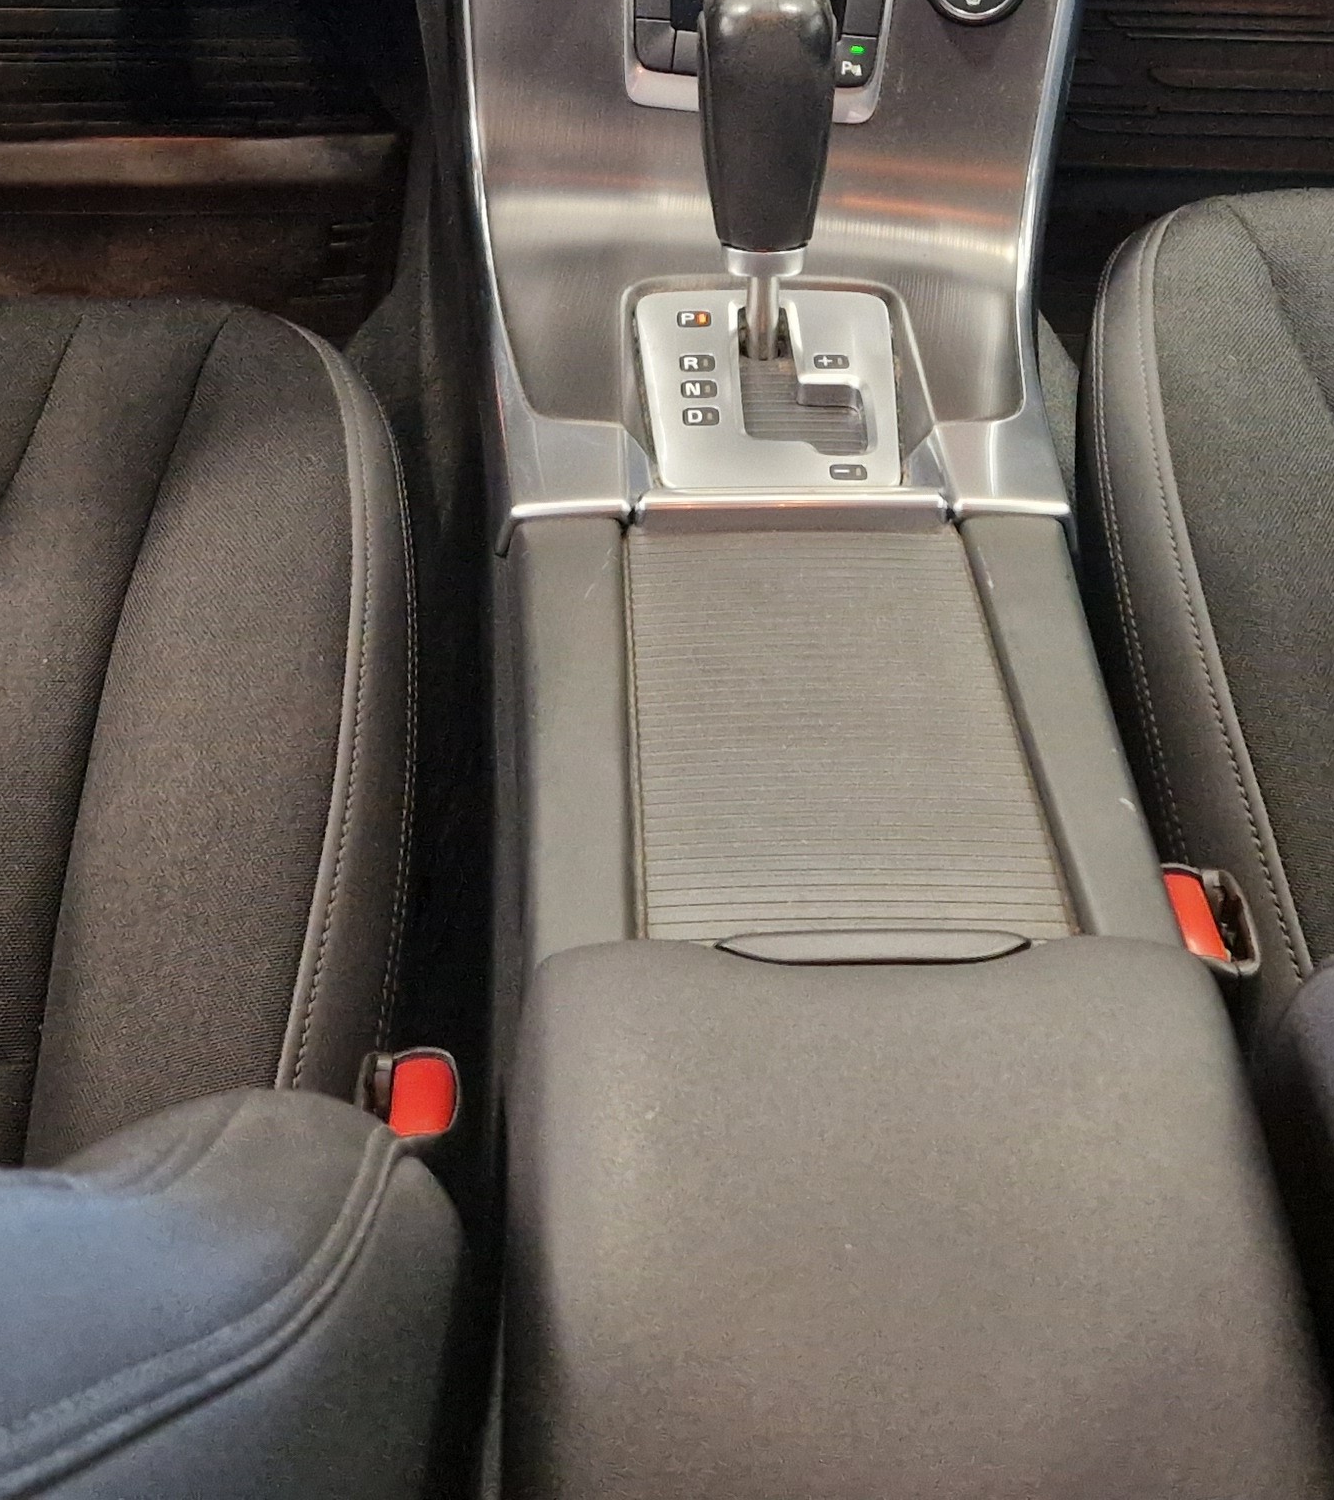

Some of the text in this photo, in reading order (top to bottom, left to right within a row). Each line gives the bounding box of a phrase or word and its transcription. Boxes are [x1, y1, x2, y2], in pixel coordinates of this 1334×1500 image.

[680, 313, 695, 325] P
[683, 357, 699, 370] R
[685, 383, 701, 396] N
[687, 410, 703, 423] D
